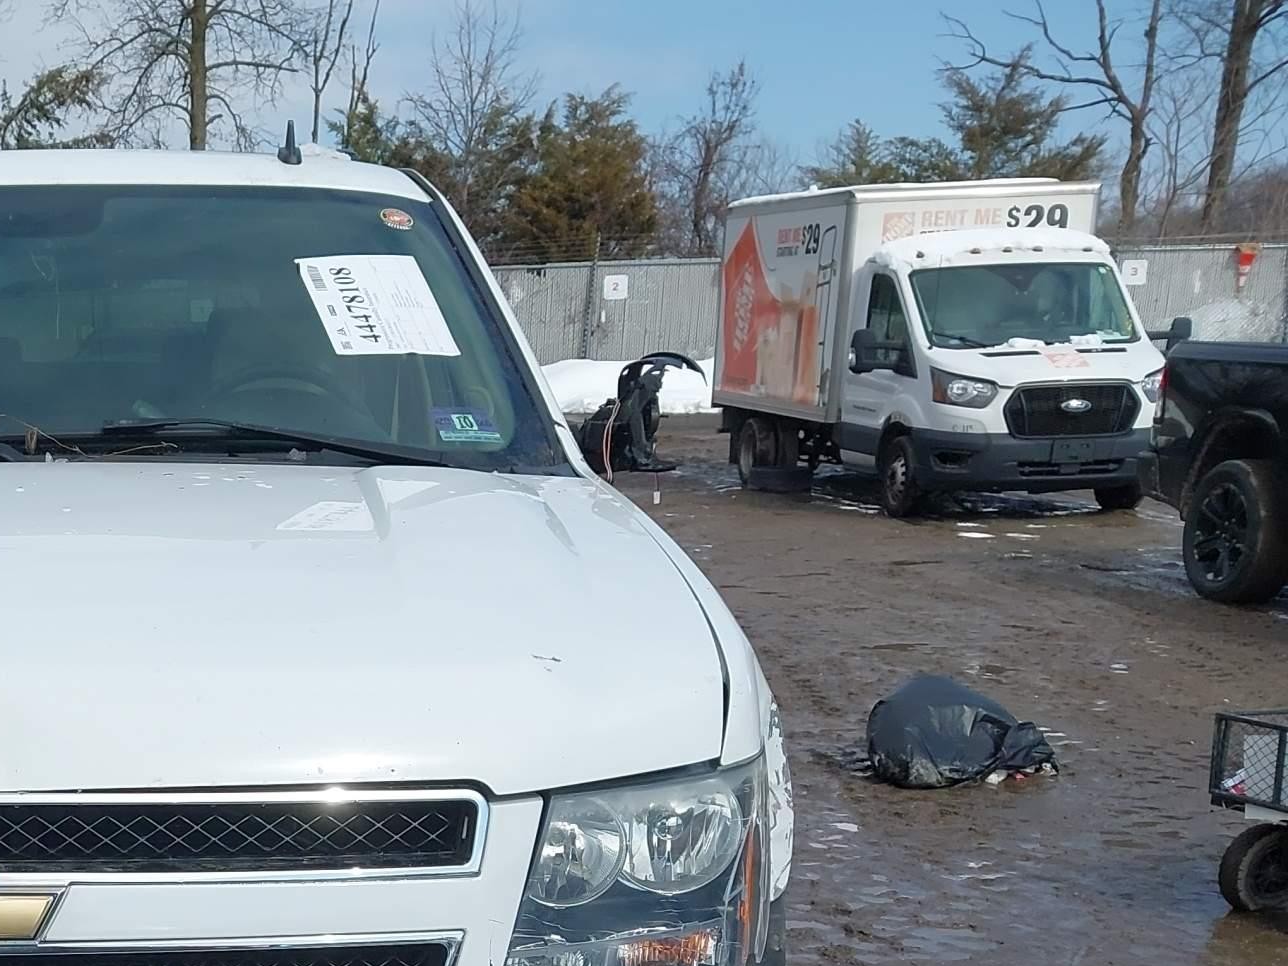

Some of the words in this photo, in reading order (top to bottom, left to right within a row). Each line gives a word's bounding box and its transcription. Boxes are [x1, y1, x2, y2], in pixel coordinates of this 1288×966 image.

[920, 209, 968, 228] RENT
[974, 208, 1002, 226] ME
[1006, 204, 1069, 229] $29
[802, 223, 820, 255] $29
[1130, 267, 1138, 276] 3
[612, 282, 619, 291] 2
[328, 266, 382, 343] 44478108
